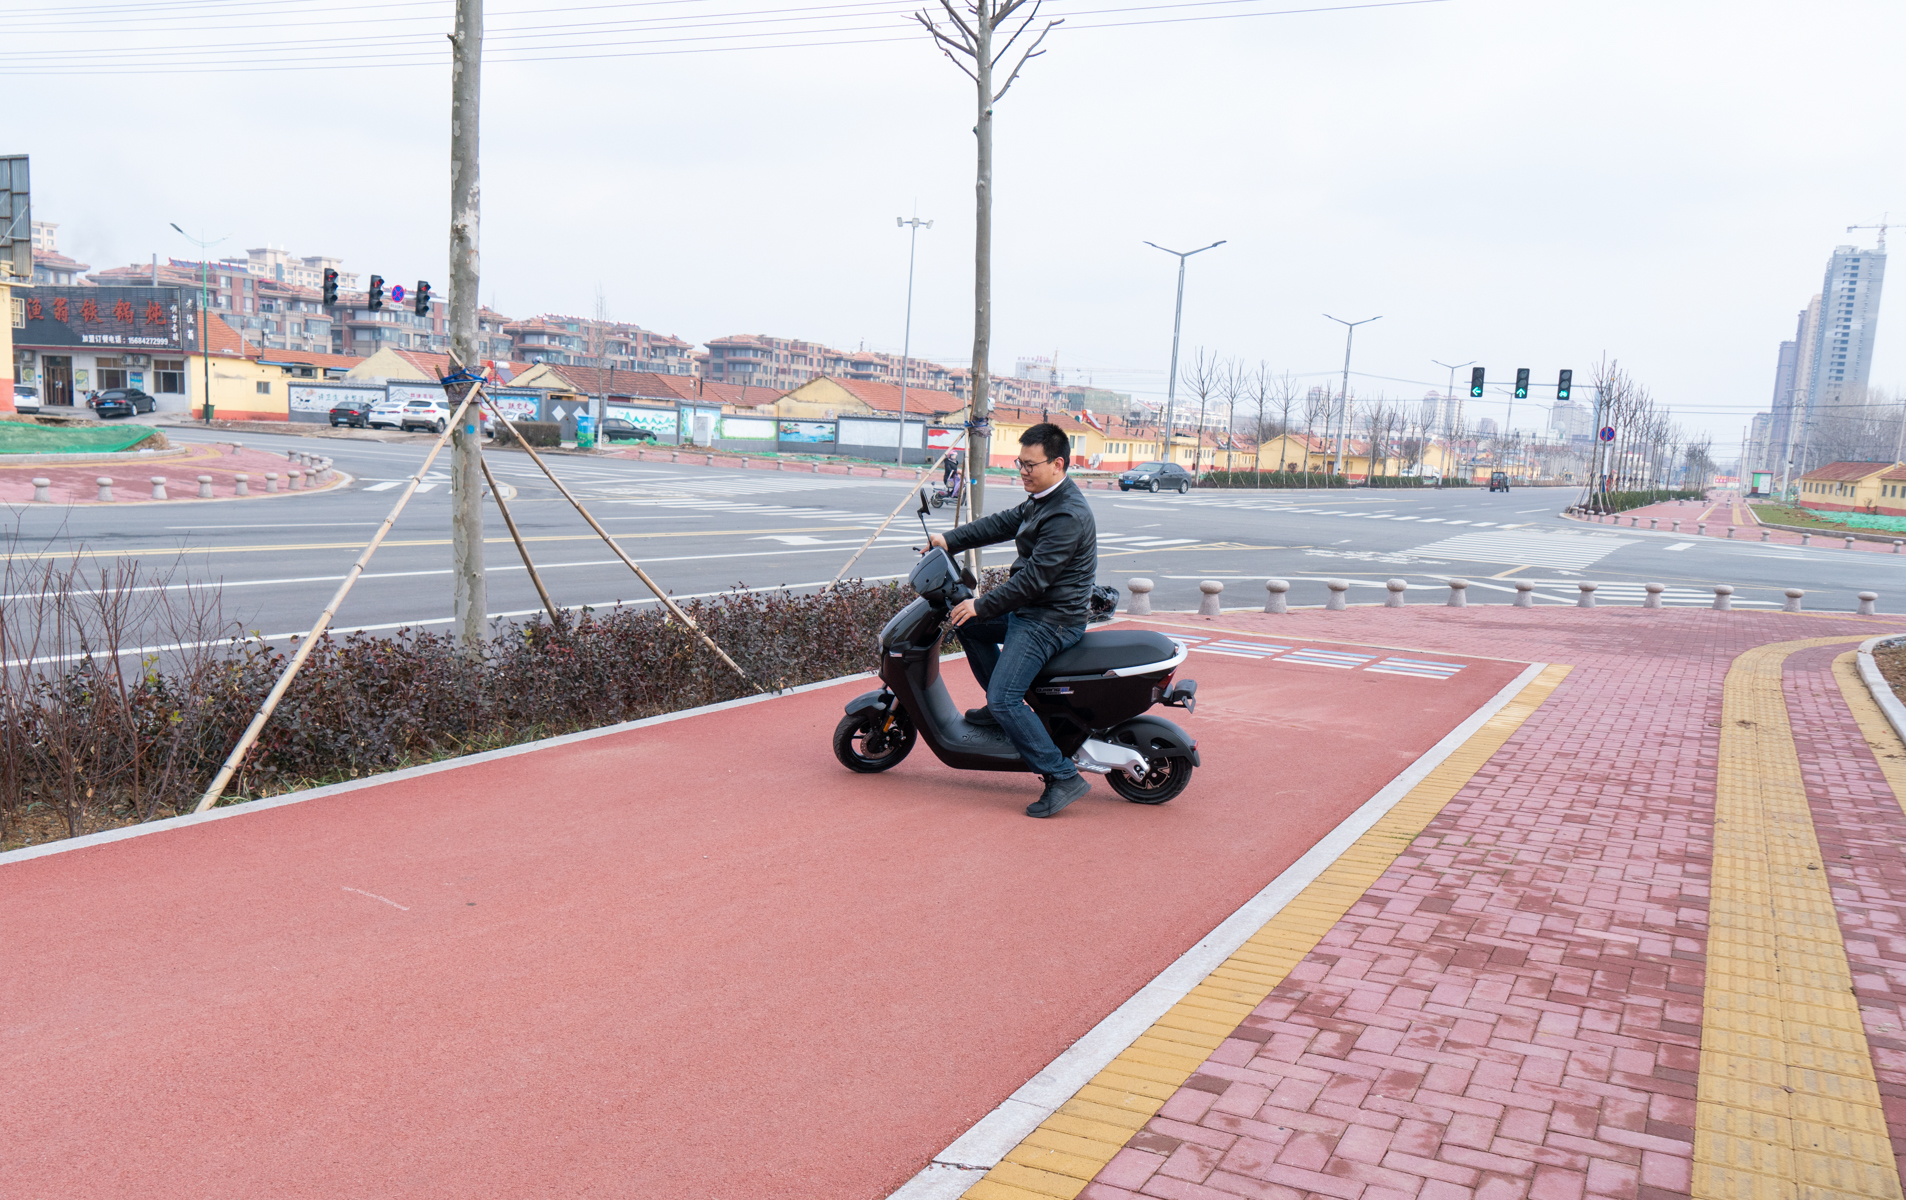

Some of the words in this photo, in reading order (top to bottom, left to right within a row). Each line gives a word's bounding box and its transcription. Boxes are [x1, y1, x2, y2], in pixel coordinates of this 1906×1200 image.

[27, 297, 167, 325] 渔翁铁锅炖
